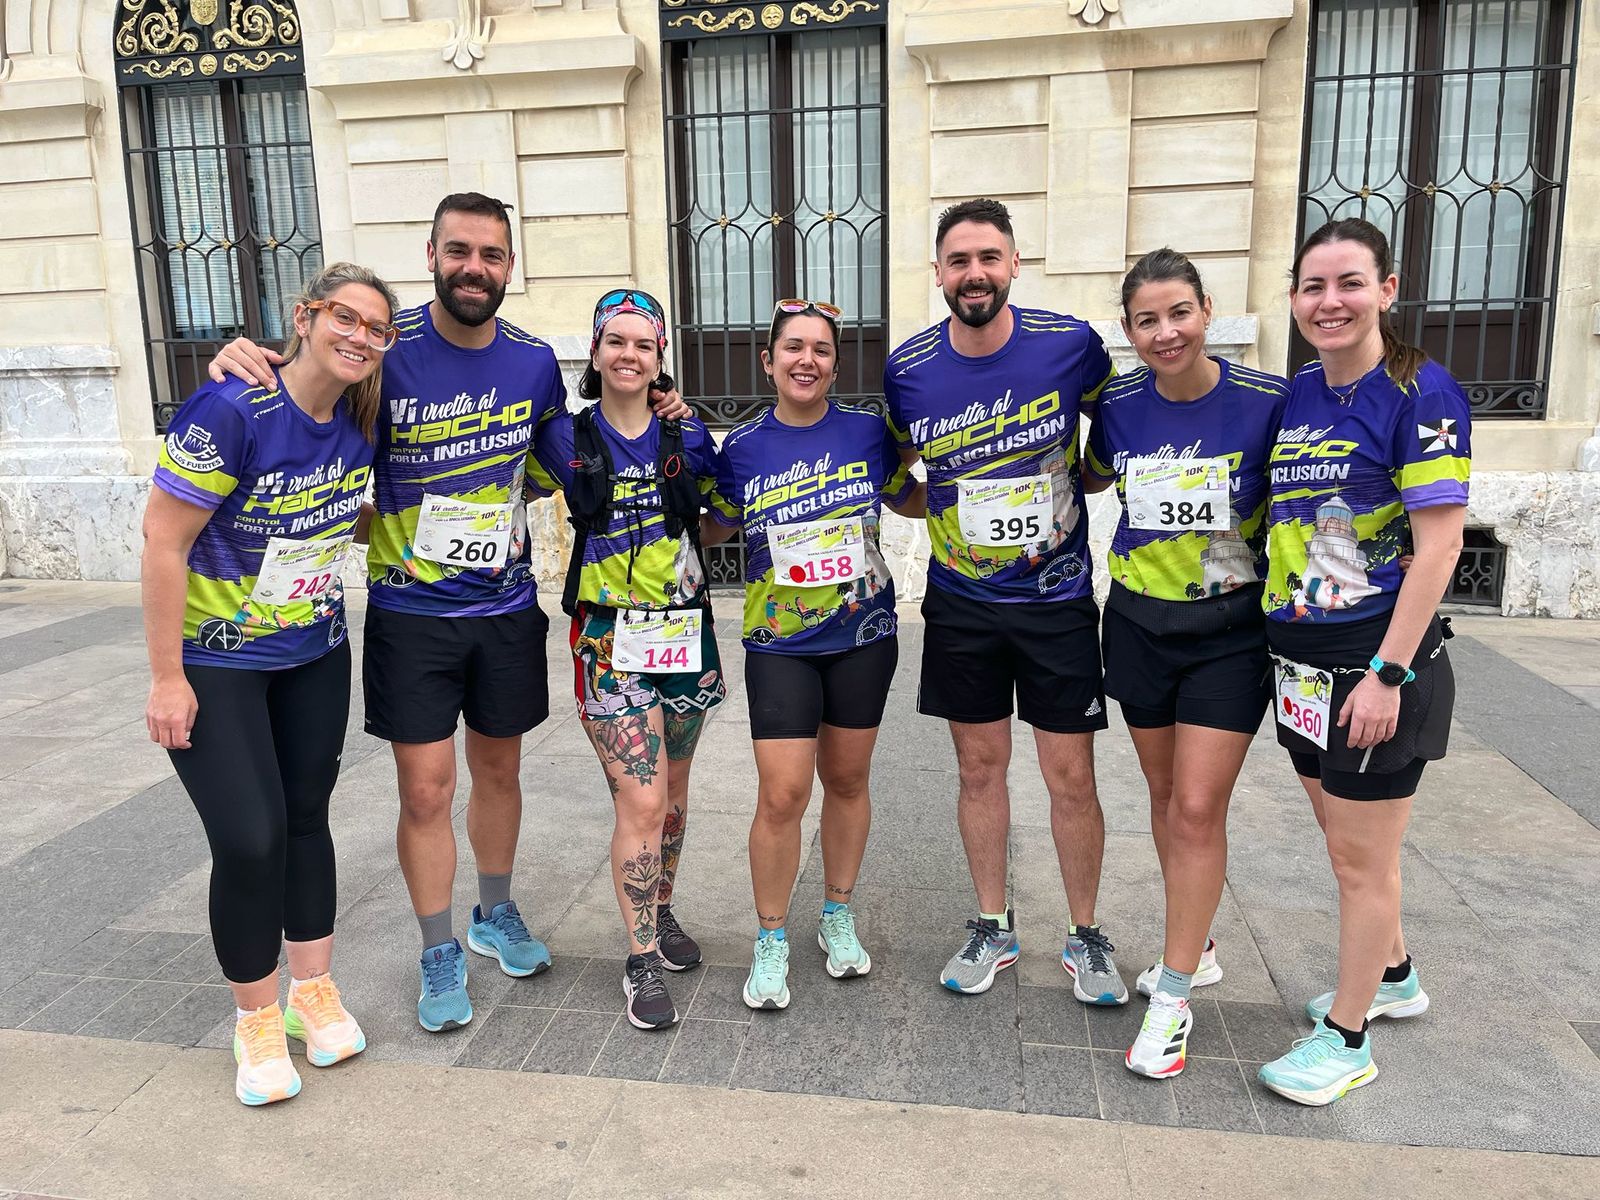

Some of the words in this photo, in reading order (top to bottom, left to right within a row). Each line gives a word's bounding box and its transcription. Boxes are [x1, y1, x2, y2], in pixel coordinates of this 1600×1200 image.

[421, 392, 477, 422] vuelta
[477, 387, 498, 411] al
[932, 401, 989, 438] vuelta
[991, 389, 1013, 417] al
[433, 423, 533, 462] INCLUSIÓN
[948, 414, 1066, 468] INCLUSIÓN
[186, 457, 222, 470] FUERTES
[327, 457, 346, 481] al
[411, 454, 429, 464] LA
[763, 460, 813, 491] vuelta
[813, 452, 832, 475] al
[1185, 465, 1204, 477] 10K
[1014, 482, 1031, 495] 10K
[776, 480, 875, 524] INCLUSIÓN
[1159, 501, 1215, 526] 384
[480, 510, 497, 520] 10K
[989, 514, 1040, 541] 395
[233, 521, 264, 535] POR
[266, 526, 286, 535] LA
[823, 524, 841, 537] 10K
[446, 538, 498, 563] 260
[804, 555, 854, 582] 158
[287, 573, 332, 600] 242
[668, 616, 684, 627] 10K
[643, 646, 689, 668] 144
[1292, 703, 1322, 739] 360
